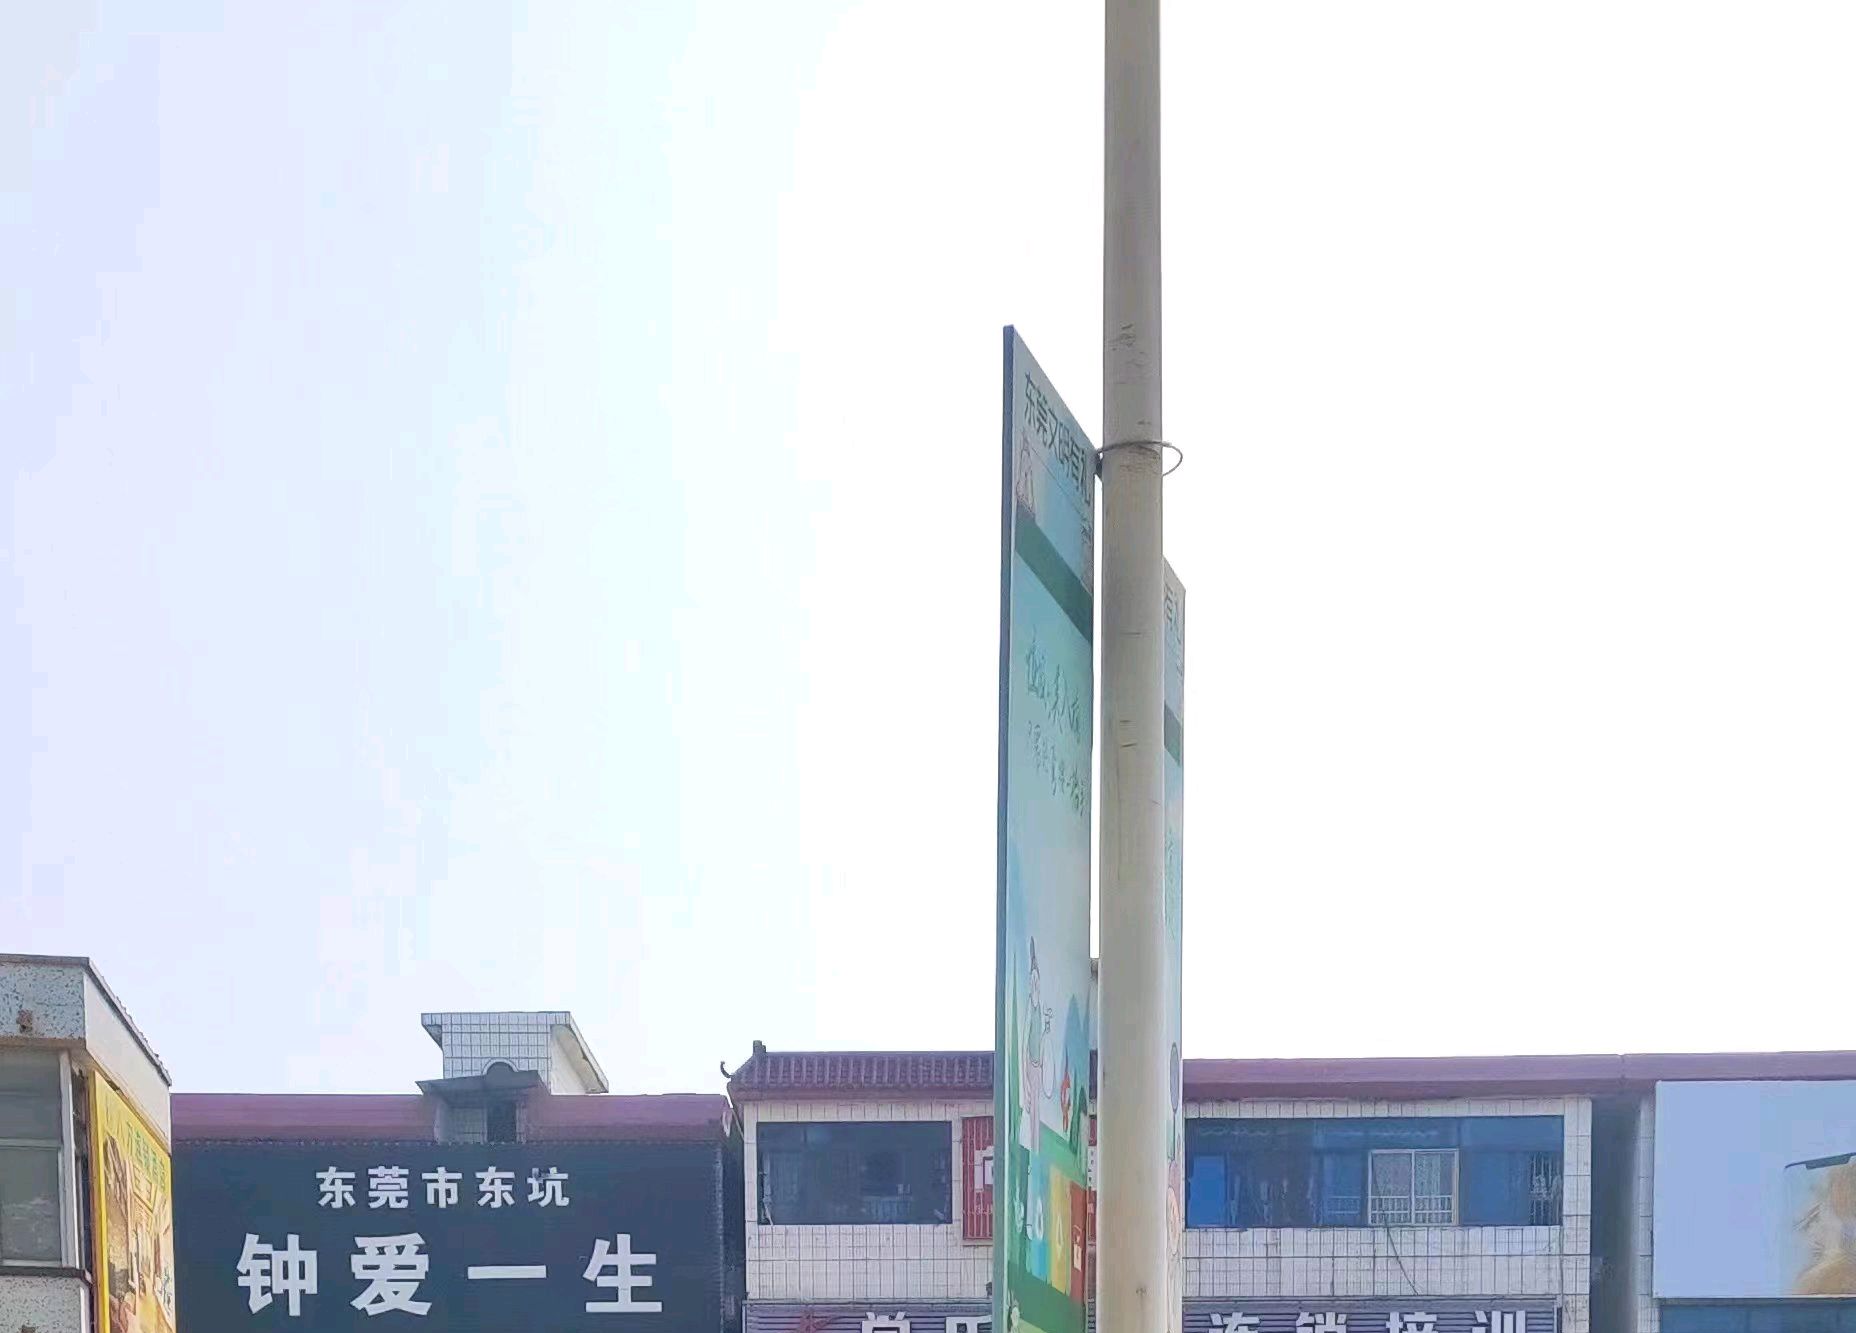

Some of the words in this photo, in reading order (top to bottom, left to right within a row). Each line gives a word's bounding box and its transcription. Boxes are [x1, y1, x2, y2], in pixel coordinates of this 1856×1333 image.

[316, 1167, 571, 1209] 东莞市东坑
[237, 1233, 662, 1317] 钟爱一生
